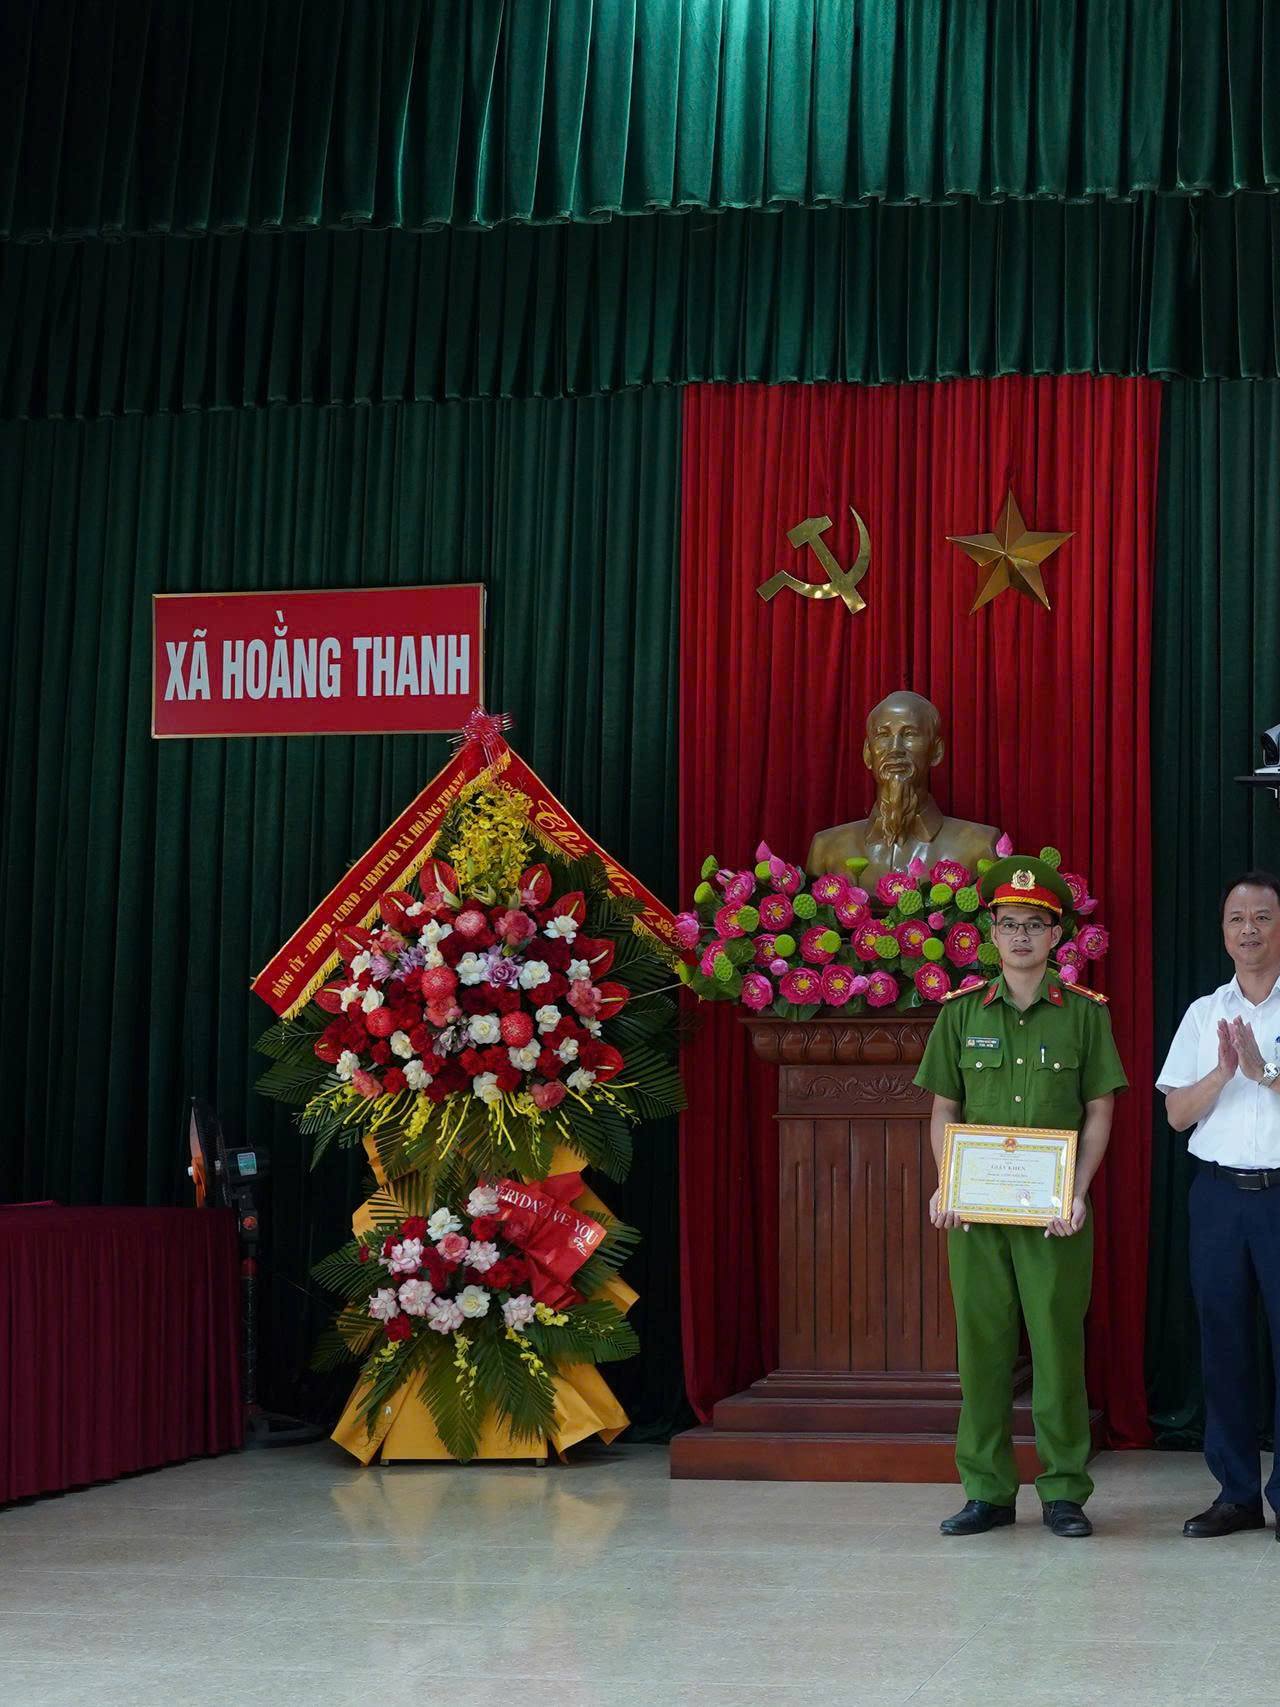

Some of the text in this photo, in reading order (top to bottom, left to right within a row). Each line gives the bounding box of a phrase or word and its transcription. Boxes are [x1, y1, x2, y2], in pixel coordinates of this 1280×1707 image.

[164, 609, 470, 701] XÃ HOẰNG THANH
[534, 799, 589, 859] Chú
[573, 1218, 599, 1245] YOU
